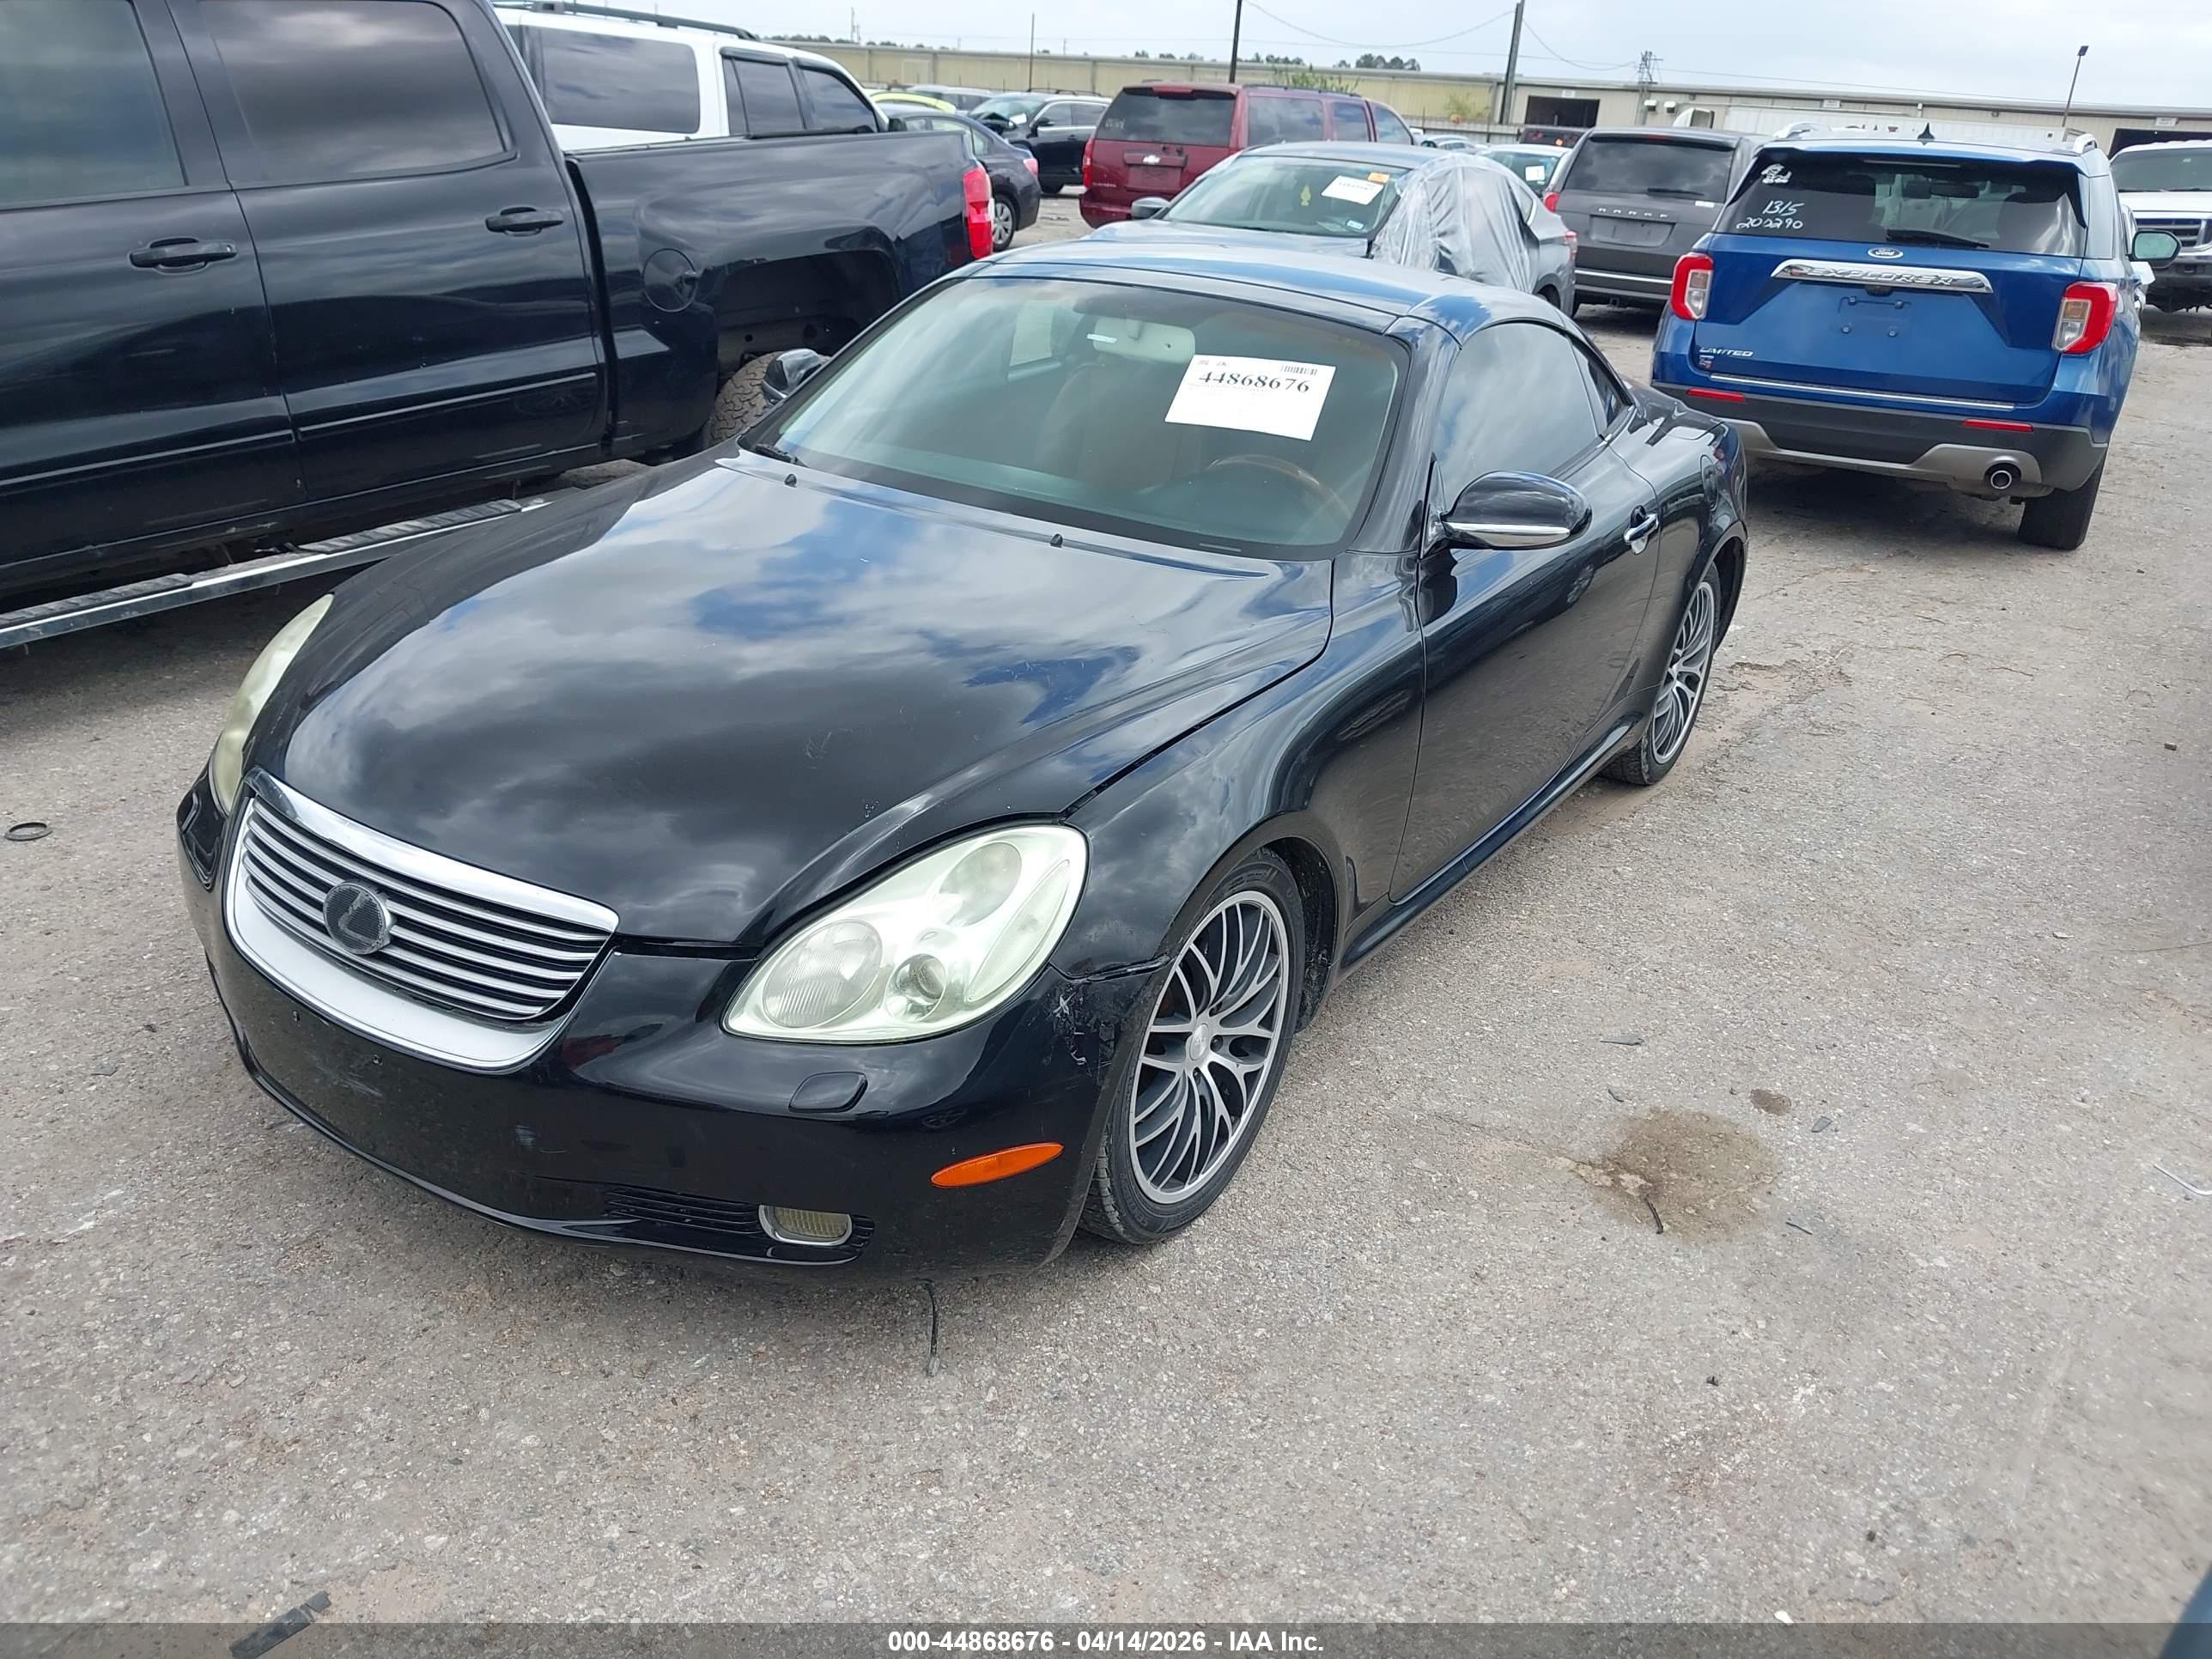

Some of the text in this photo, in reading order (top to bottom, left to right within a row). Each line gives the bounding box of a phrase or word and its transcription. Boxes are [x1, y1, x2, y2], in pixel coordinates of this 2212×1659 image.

[1762, 200, 1805, 216] 1315
[1806, 267, 1954, 286] EXPLORER
[1199, 370, 1310, 393] 44868676
